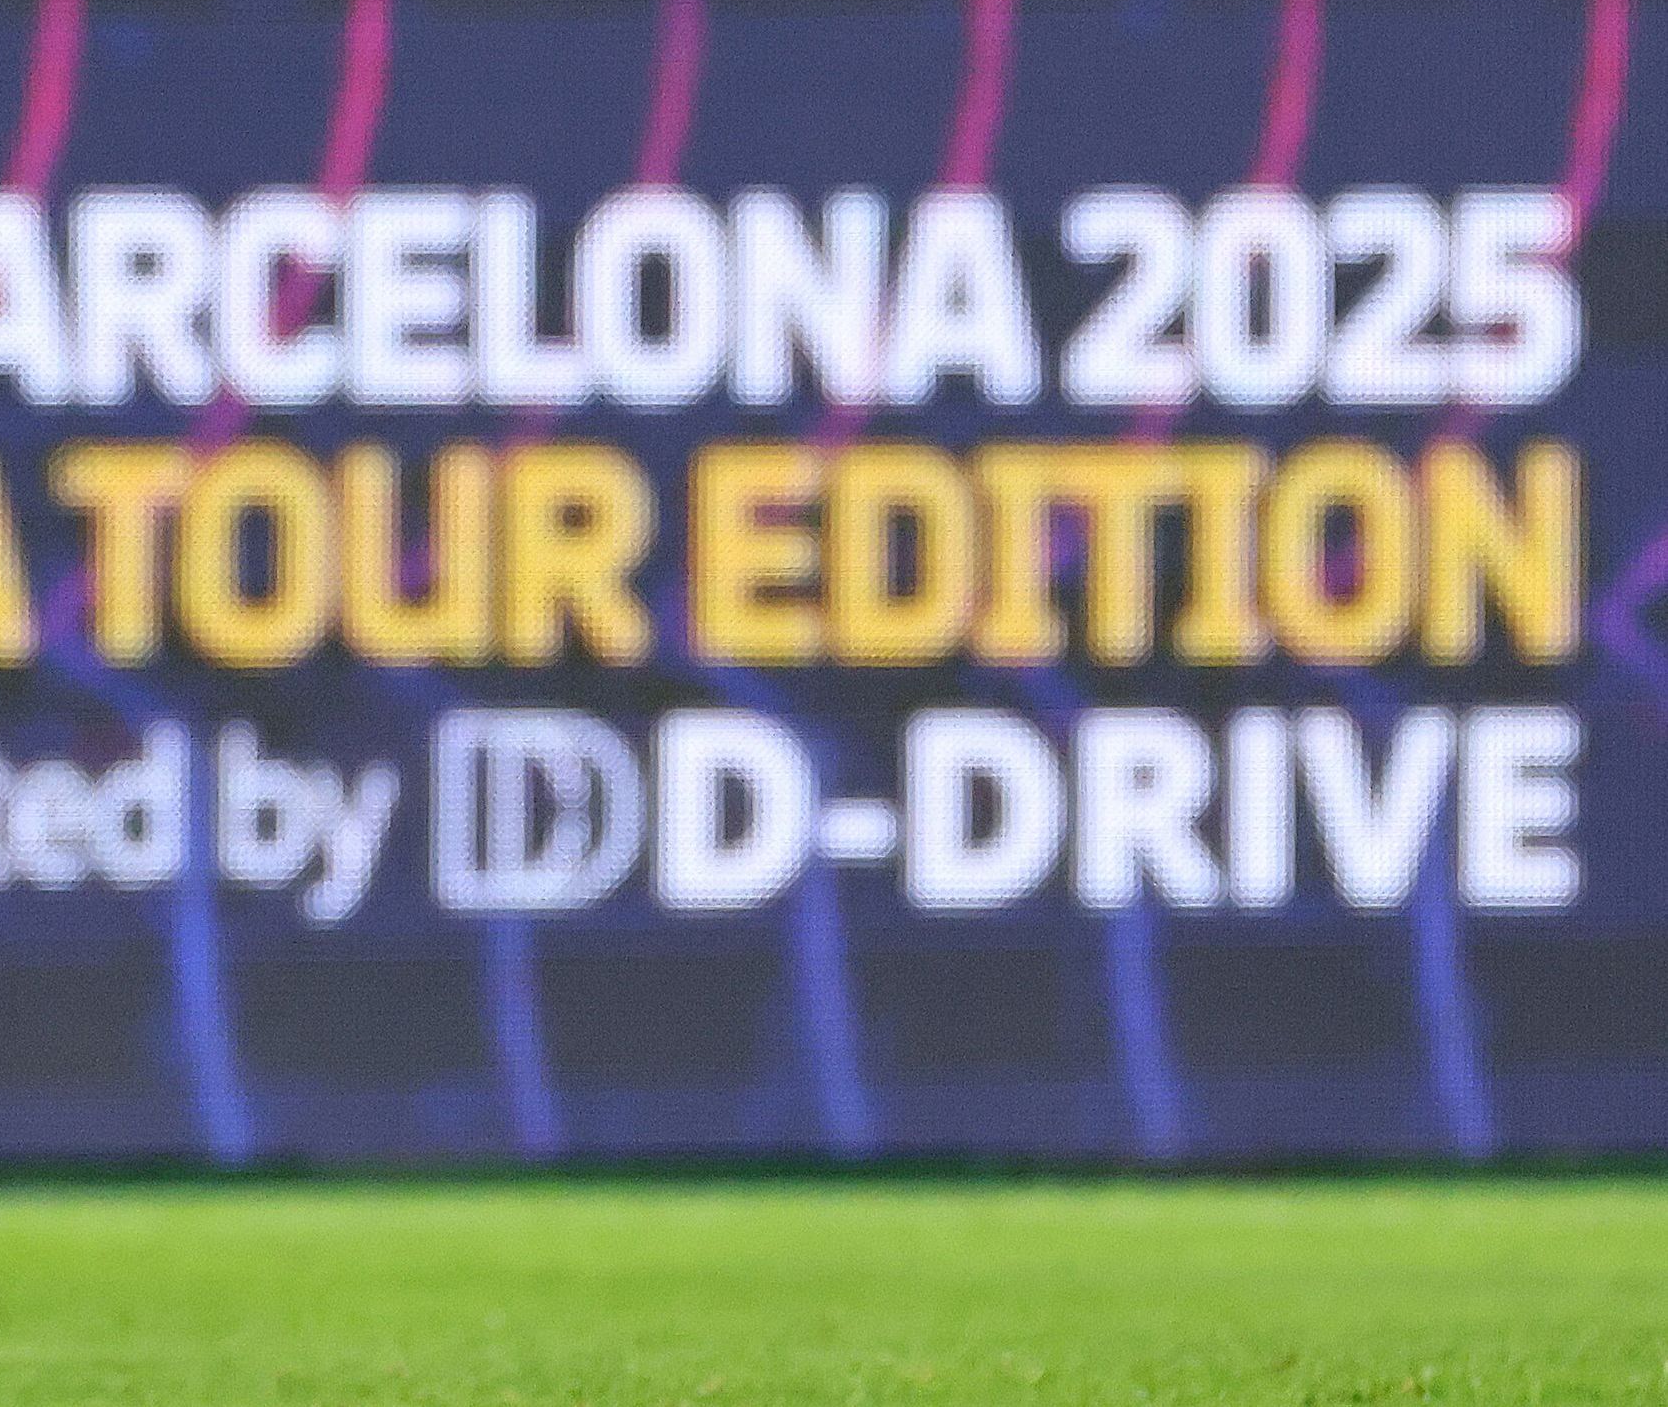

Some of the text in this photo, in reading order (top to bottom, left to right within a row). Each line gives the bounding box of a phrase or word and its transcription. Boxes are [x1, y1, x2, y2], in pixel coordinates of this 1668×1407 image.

[1061, 185, 1583, 411] 2025
[51, 439, 655, 670] TOUR
[687, 439, 1582, 669] EDITION
[217, 721, 403, 925] by
